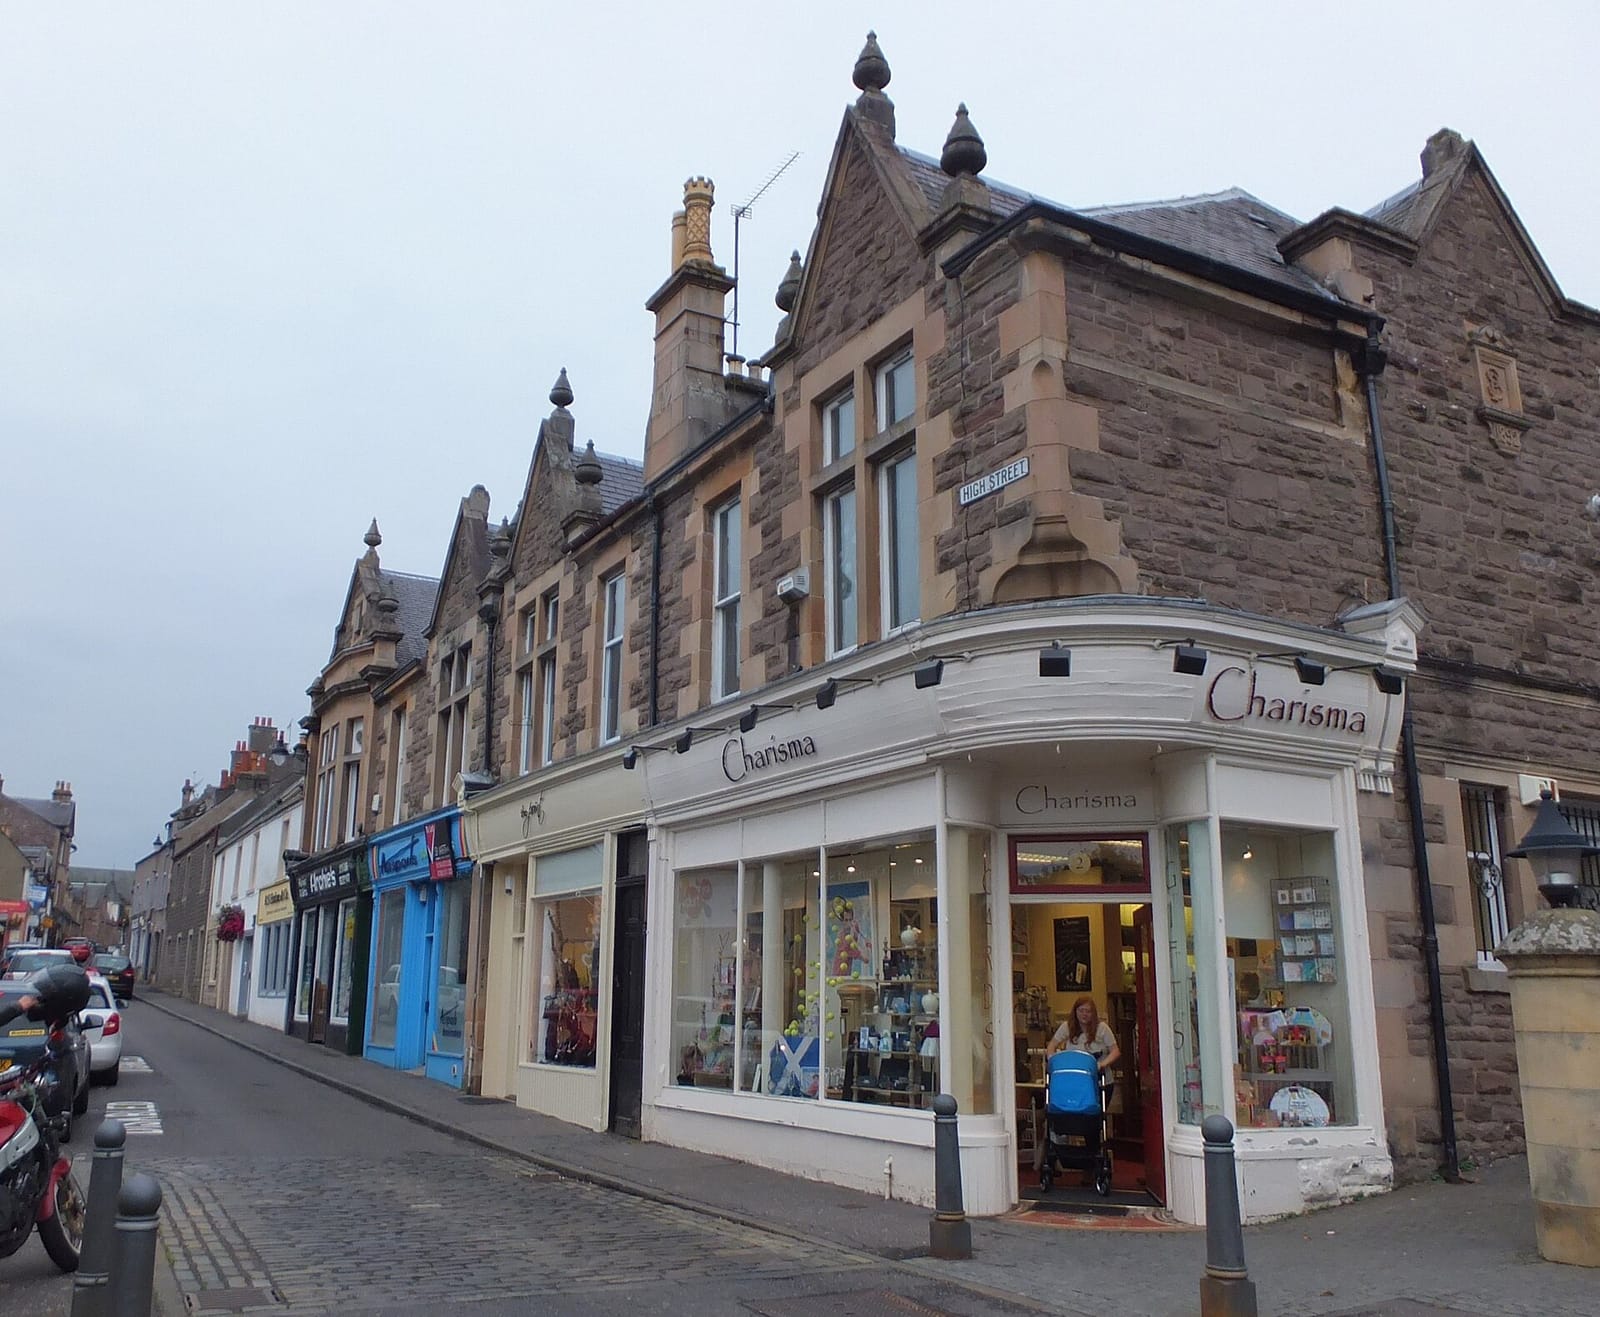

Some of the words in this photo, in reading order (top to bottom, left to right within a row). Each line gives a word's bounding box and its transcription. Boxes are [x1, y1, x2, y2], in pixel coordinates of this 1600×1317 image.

[963, 479, 985, 501] HIGH
[989, 460, 1025, 490] STREET
[1209, 666, 1366, 733] Charisma
[722, 734, 816, 782] Charisma
[1015, 785, 1137, 815] Charisma
